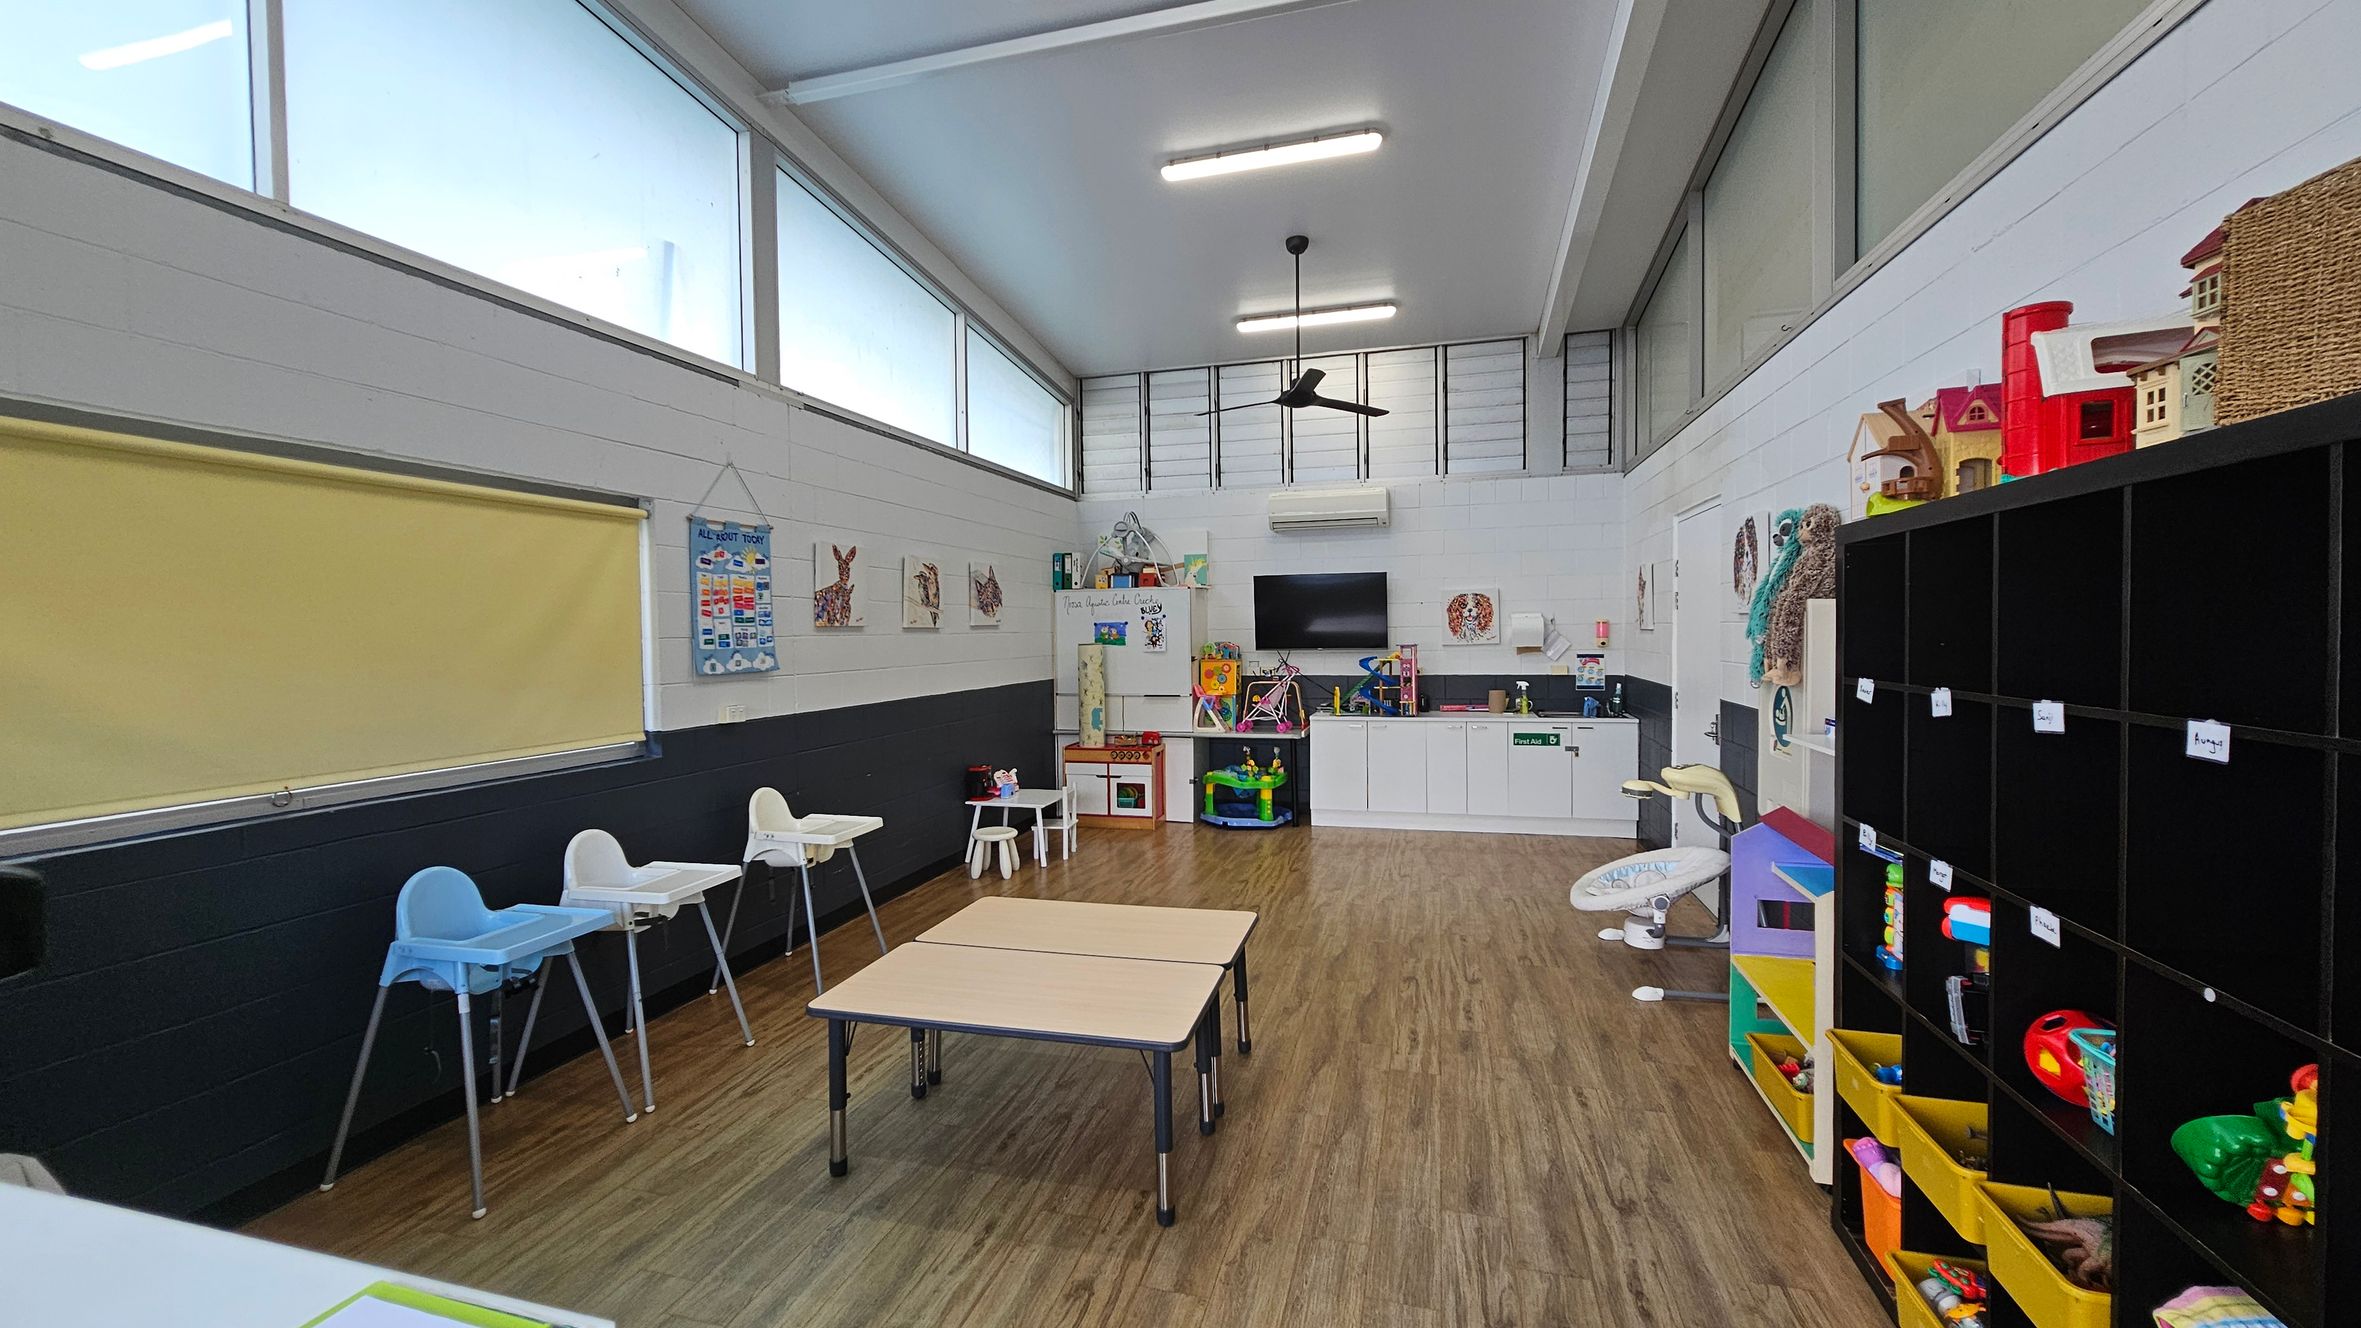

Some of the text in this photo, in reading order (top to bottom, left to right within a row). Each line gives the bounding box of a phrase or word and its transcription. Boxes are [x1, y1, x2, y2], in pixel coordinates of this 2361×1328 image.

[698, 528, 765, 545] ALL ABOUT TODAY
